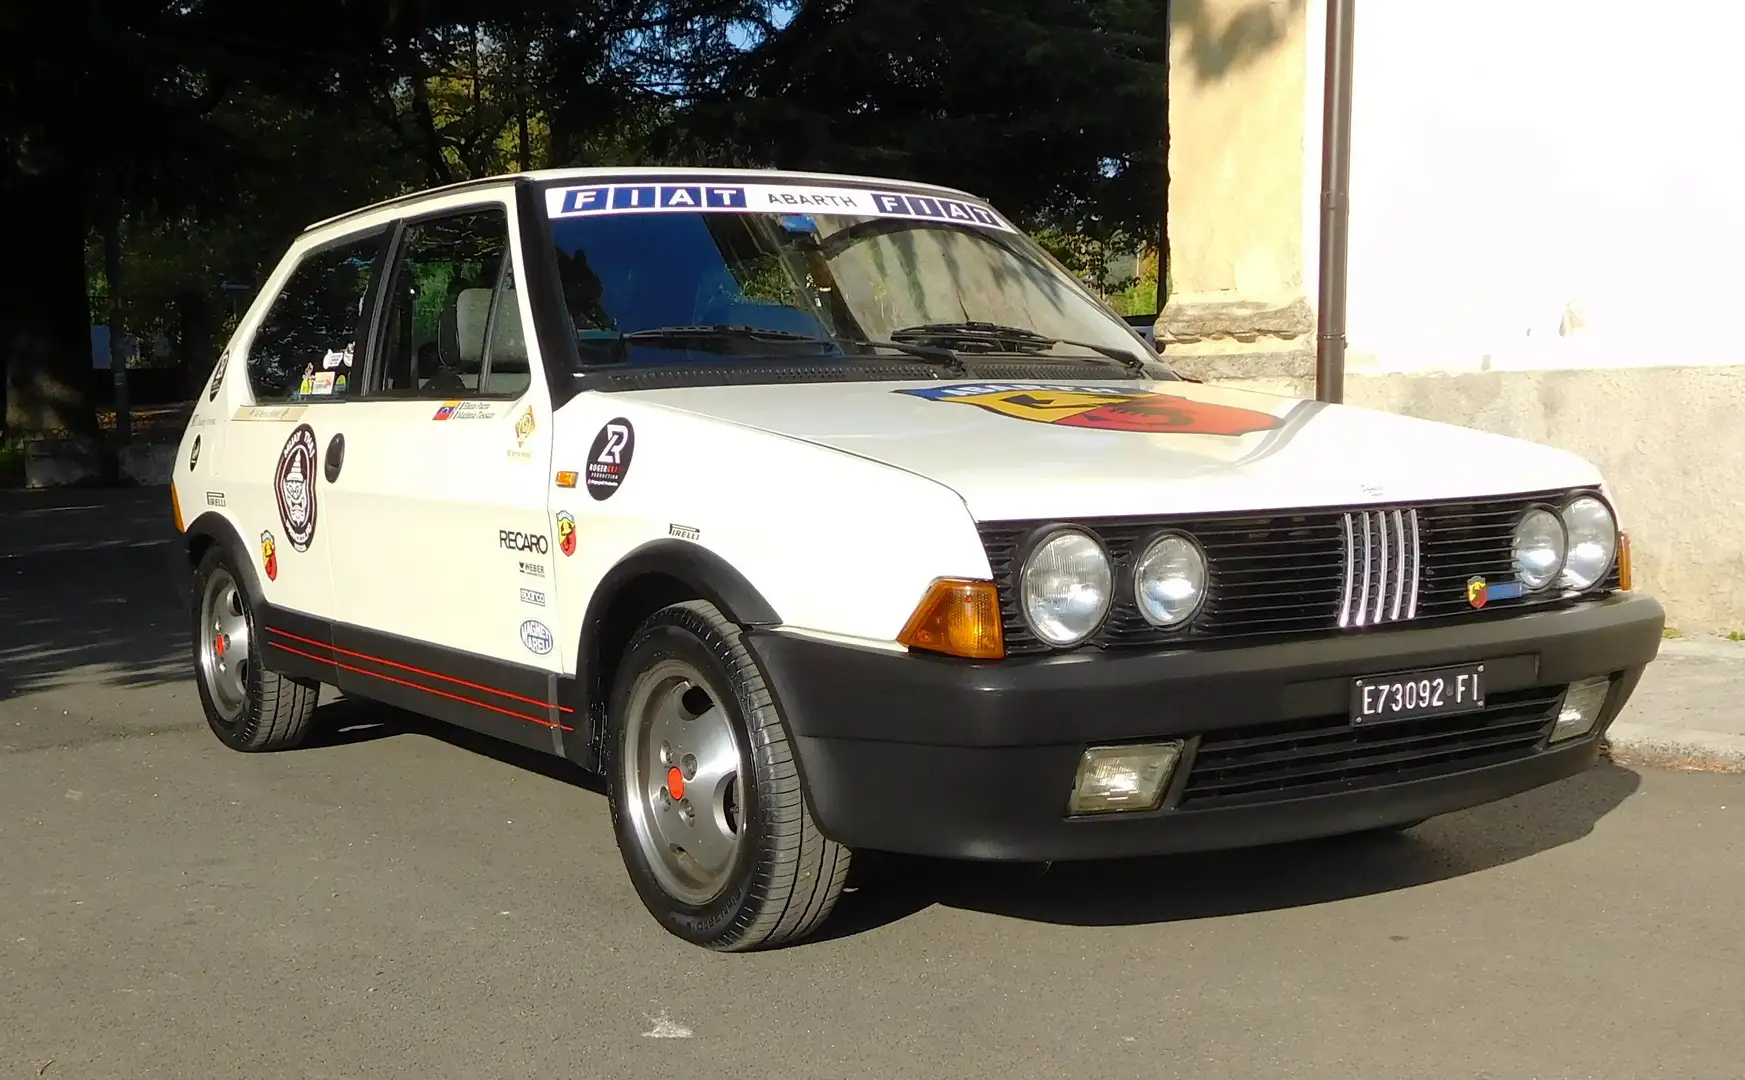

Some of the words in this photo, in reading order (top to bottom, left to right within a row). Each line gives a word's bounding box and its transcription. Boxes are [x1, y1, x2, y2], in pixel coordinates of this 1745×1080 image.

[574, 189, 737, 210] FIAT
[767, 192, 858, 208] ABARTH
[883, 195, 995, 223] FIAT
[206, 491, 226, 507] PIRELLI
[499, 529, 549, 555] RECARO
[669, 523, 700, 541] PIRELLI
[524, 563, 545, 574] WEBER
[1363, 678, 1444, 715] E73092
